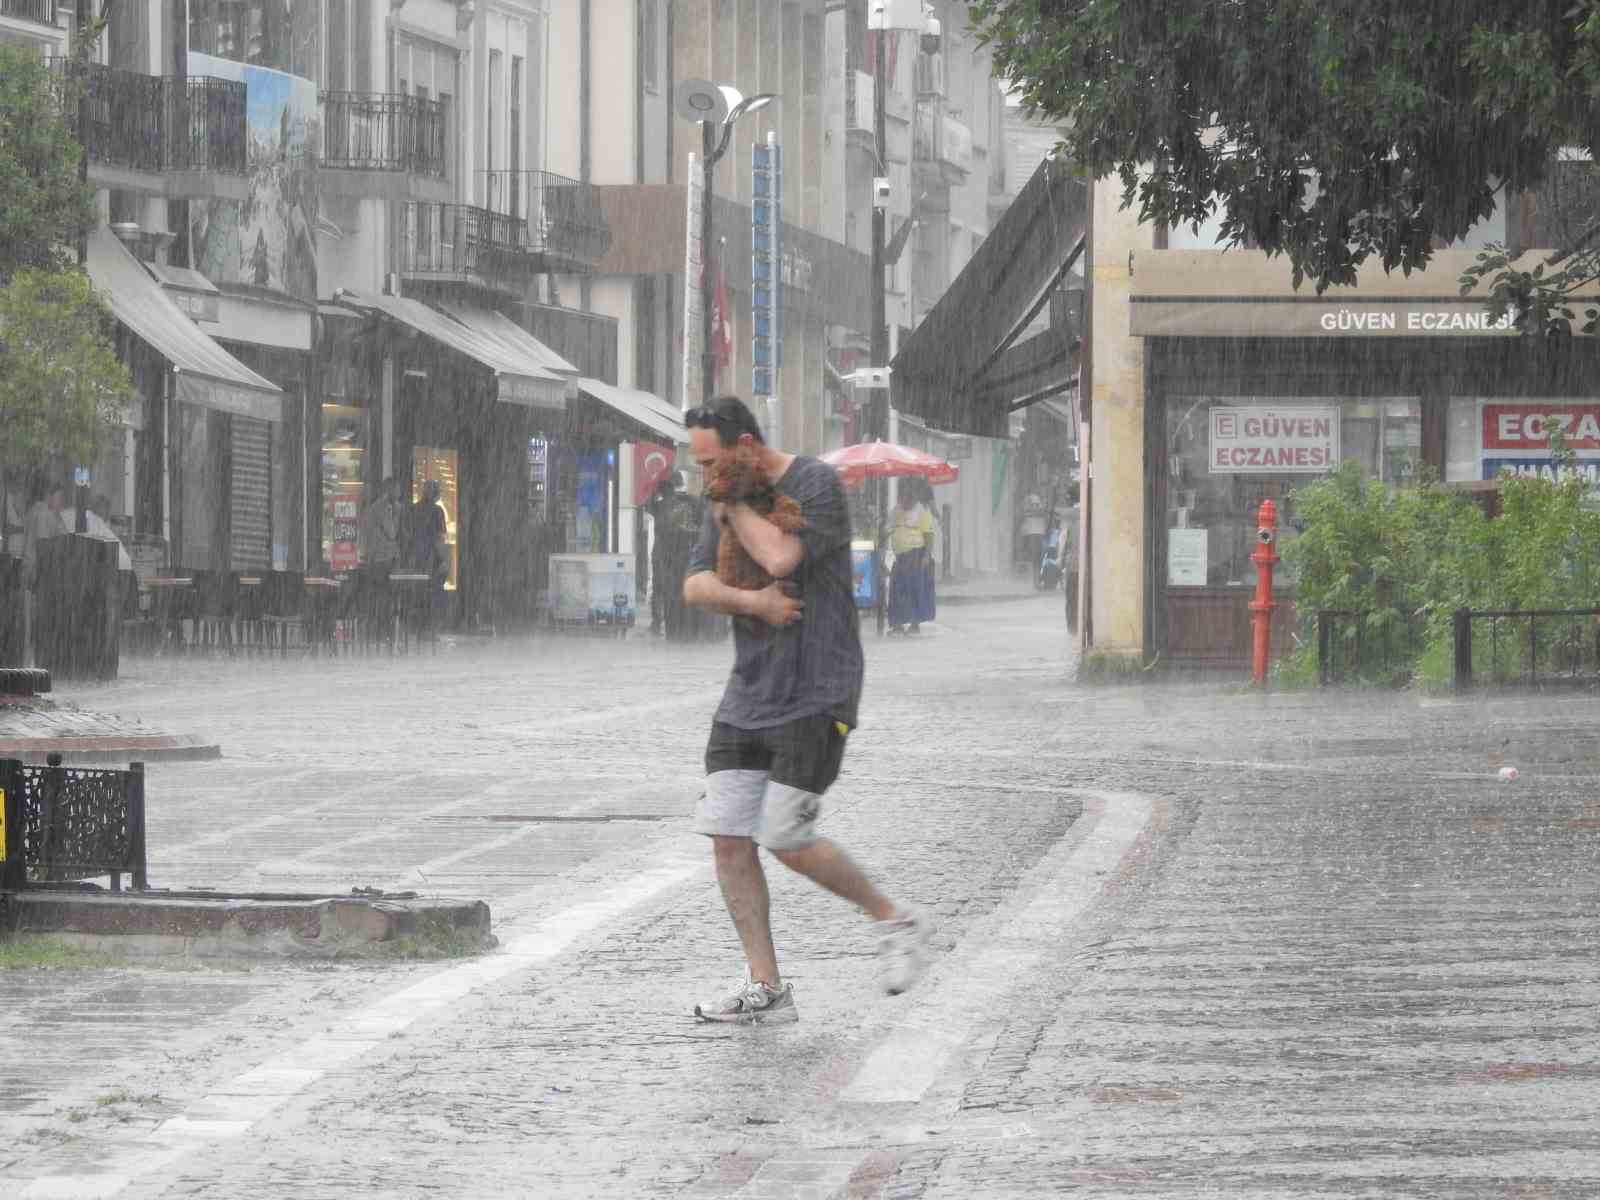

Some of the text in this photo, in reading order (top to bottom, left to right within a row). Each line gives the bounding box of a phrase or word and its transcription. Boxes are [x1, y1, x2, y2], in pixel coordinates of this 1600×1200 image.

[1320, 309, 1396, 331] GÜVEN
[1244, 412, 1330, 438] GÜVEN
[1216, 441, 1331, 466] ECZANESİ
